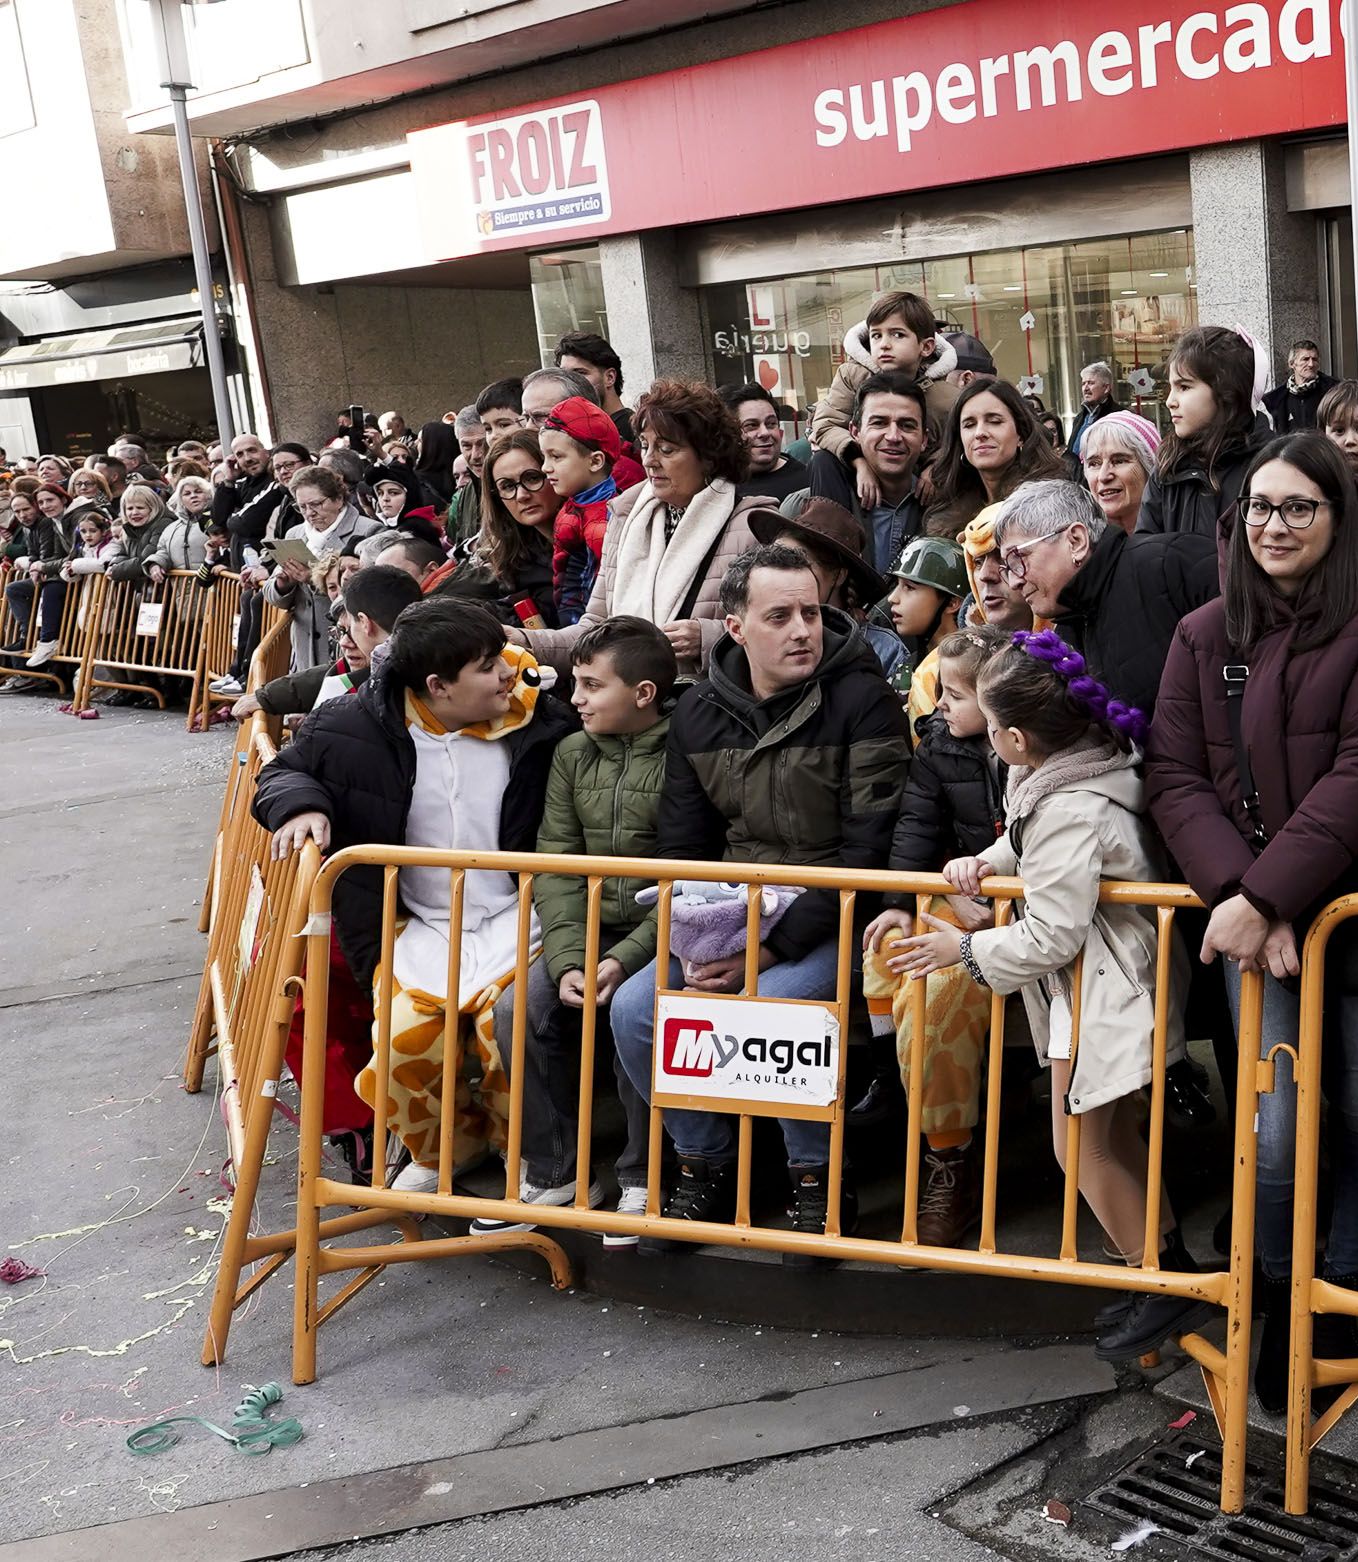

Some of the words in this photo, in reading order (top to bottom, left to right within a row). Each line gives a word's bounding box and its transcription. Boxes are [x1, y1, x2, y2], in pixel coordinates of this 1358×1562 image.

[467, 109, 597, 204] FROIZ
[494, 207, 535, 226] Siempre
[545, 206, 557, 217] su
[559, 197, 601, 216] servicio
[671, 1028, 832, 1075] Myagal
[735, 1073, 807, 1086] ALQUILER
